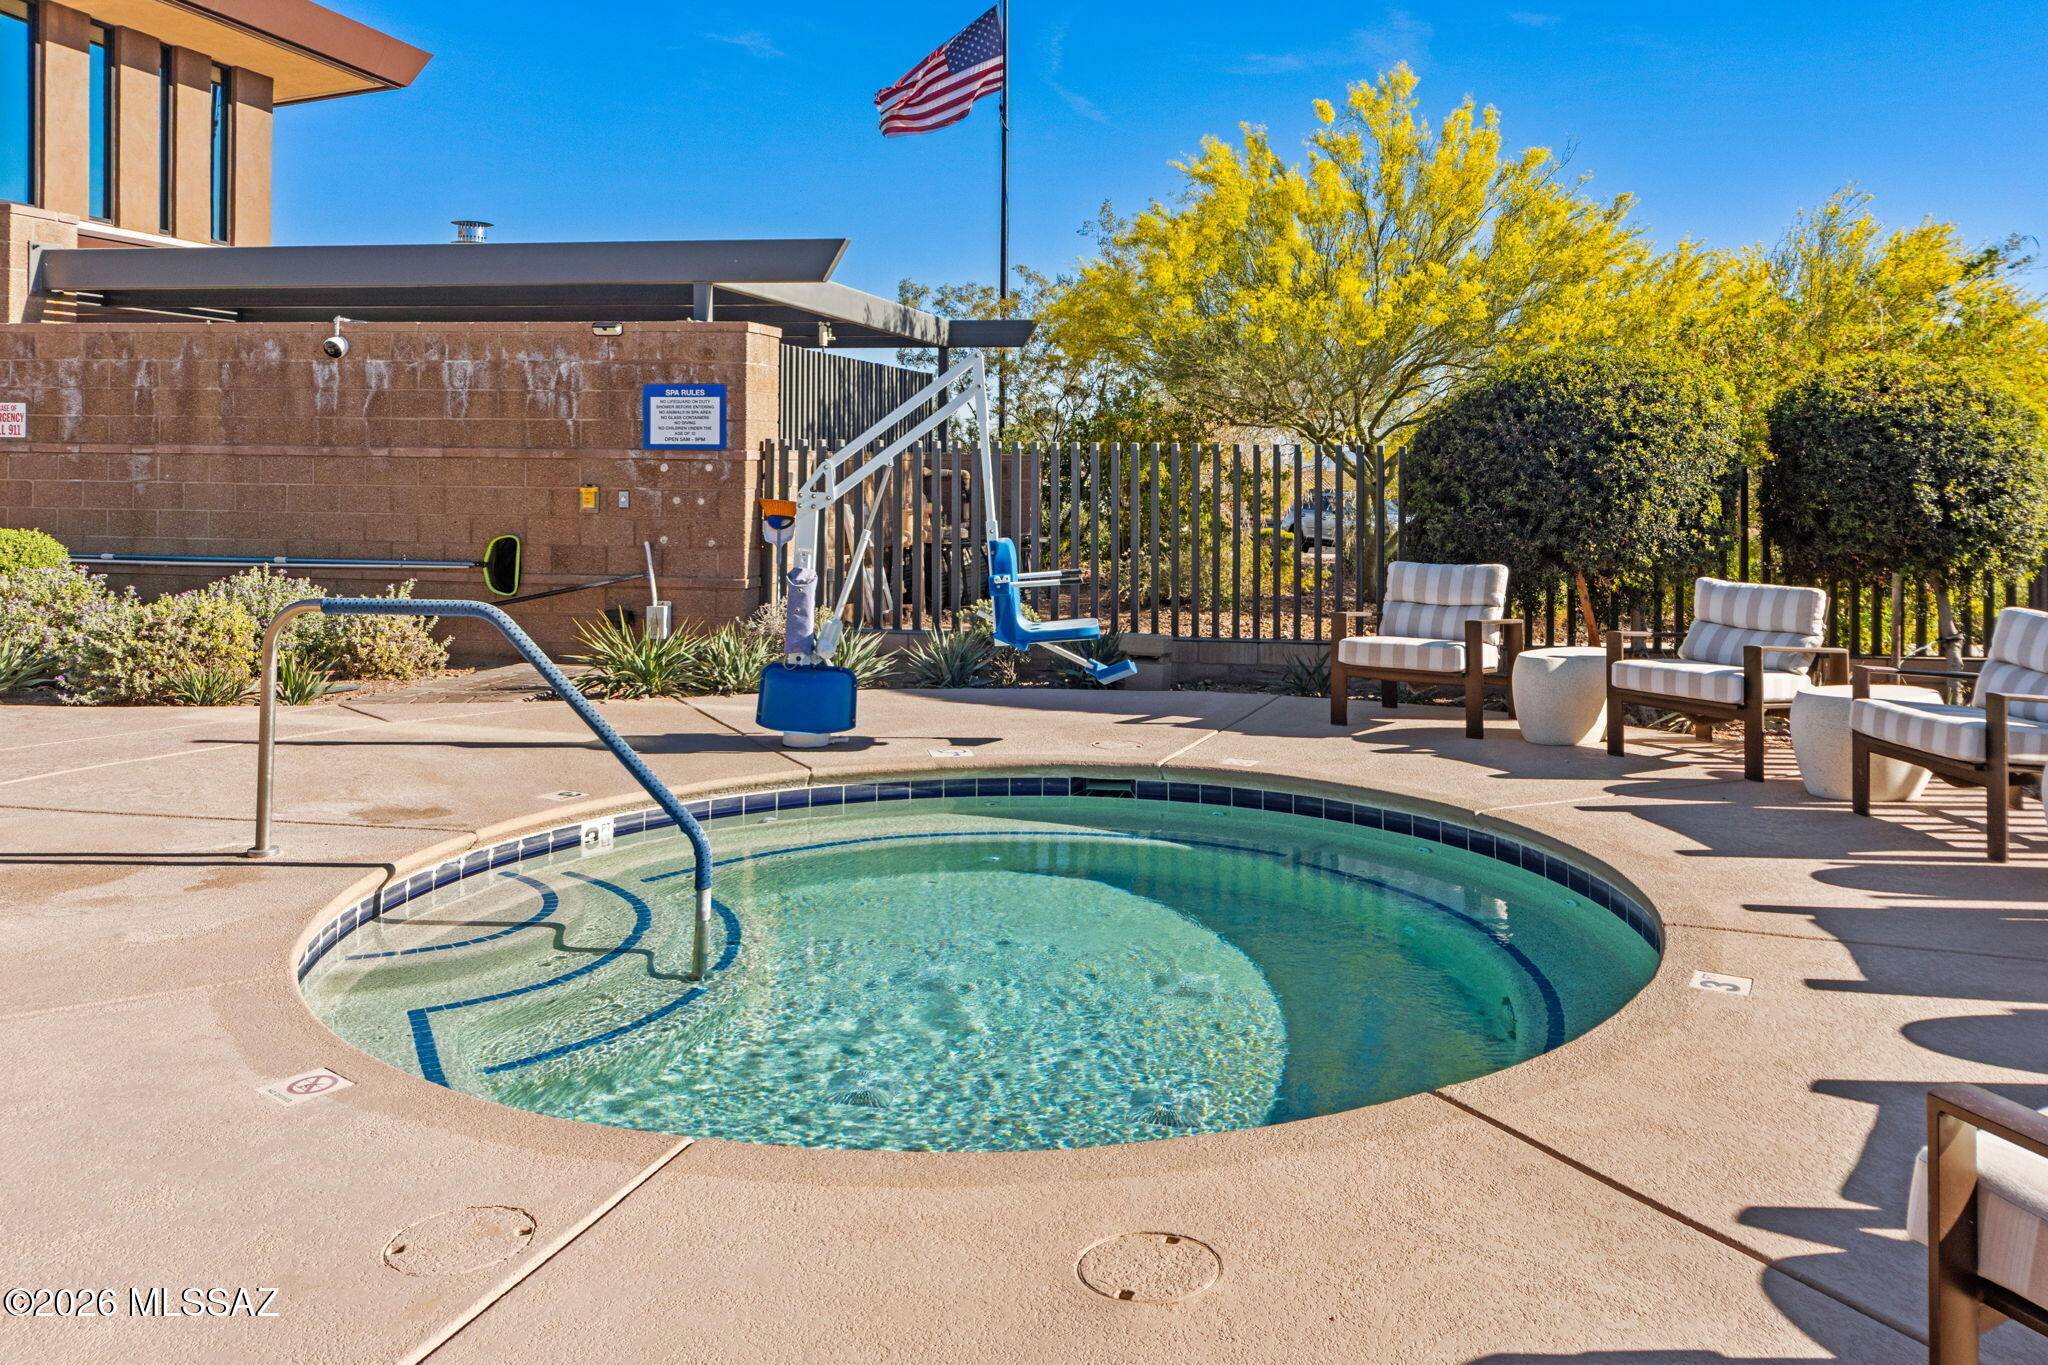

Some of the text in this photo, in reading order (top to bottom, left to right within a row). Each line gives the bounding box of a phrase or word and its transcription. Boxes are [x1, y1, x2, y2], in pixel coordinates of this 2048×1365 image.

[9, 424, 22, 435] 911
[584, 827, 599, 850] 3
[1700, 980, 1741, 991] 3
